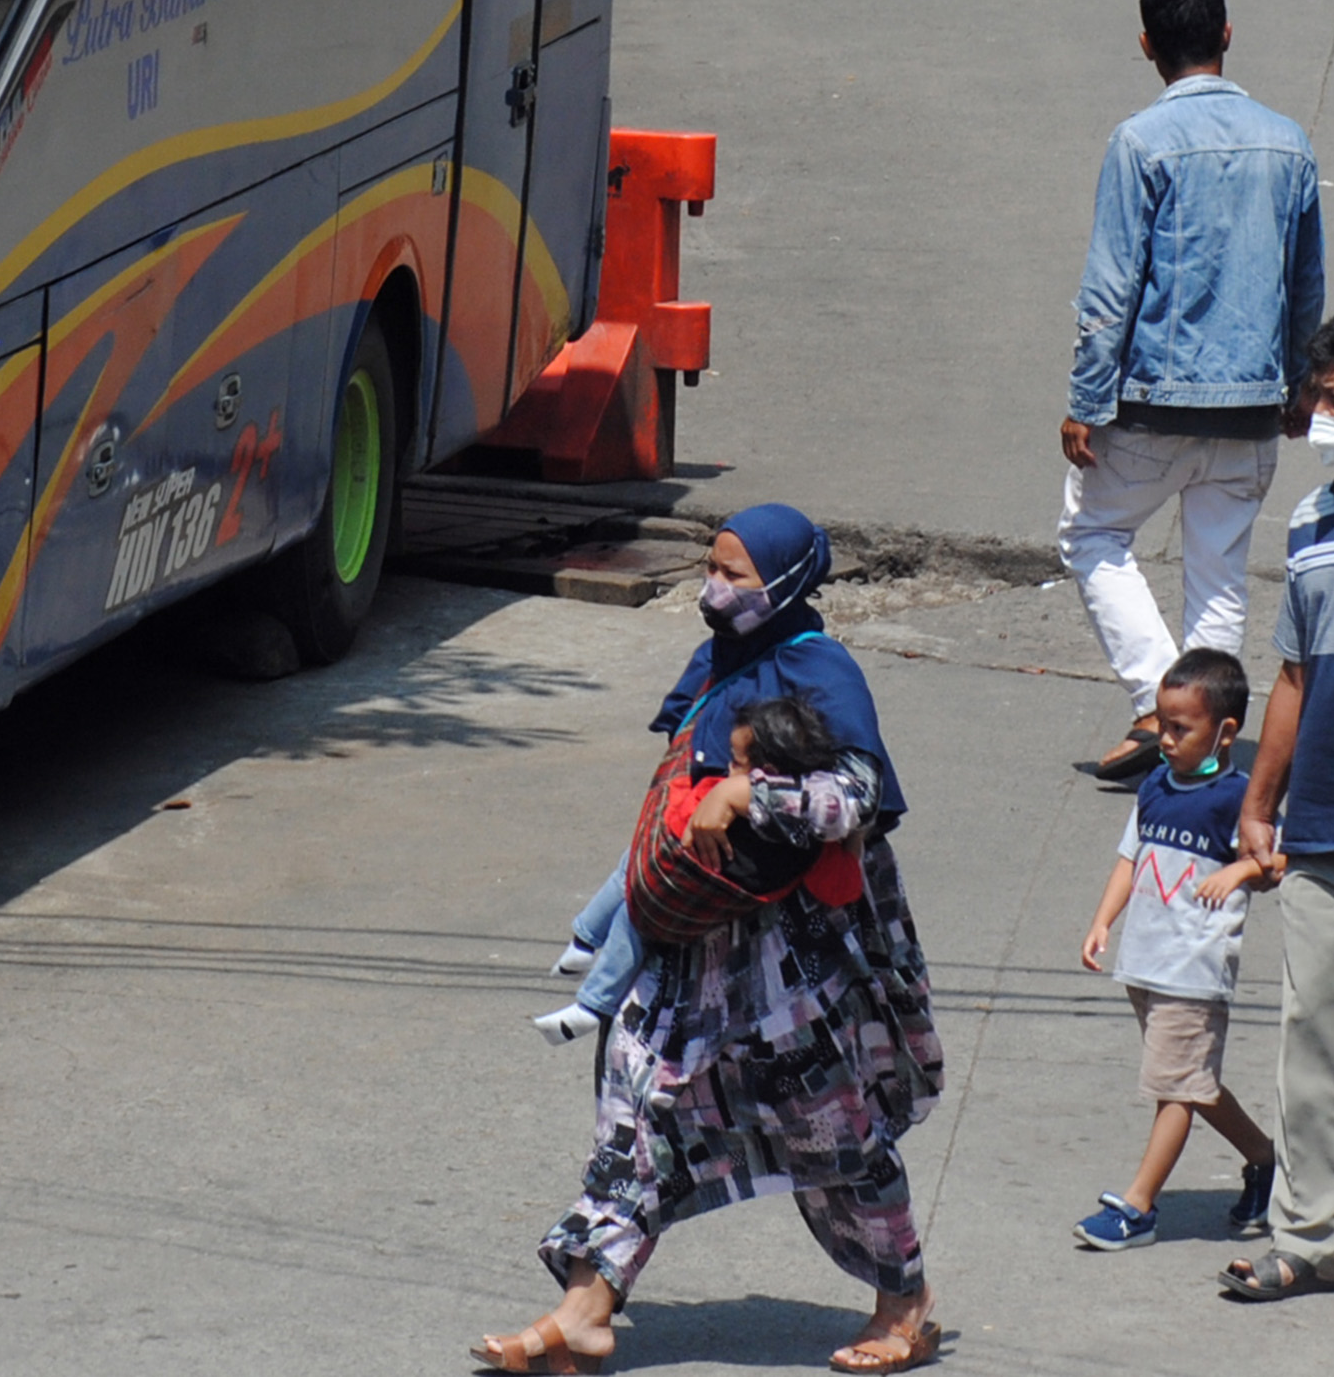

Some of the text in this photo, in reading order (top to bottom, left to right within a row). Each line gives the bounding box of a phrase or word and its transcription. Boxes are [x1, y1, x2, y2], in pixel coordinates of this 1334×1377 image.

[119, 466, 196, 540] NEW SUPER
[164, 482, 222, 578] 136
